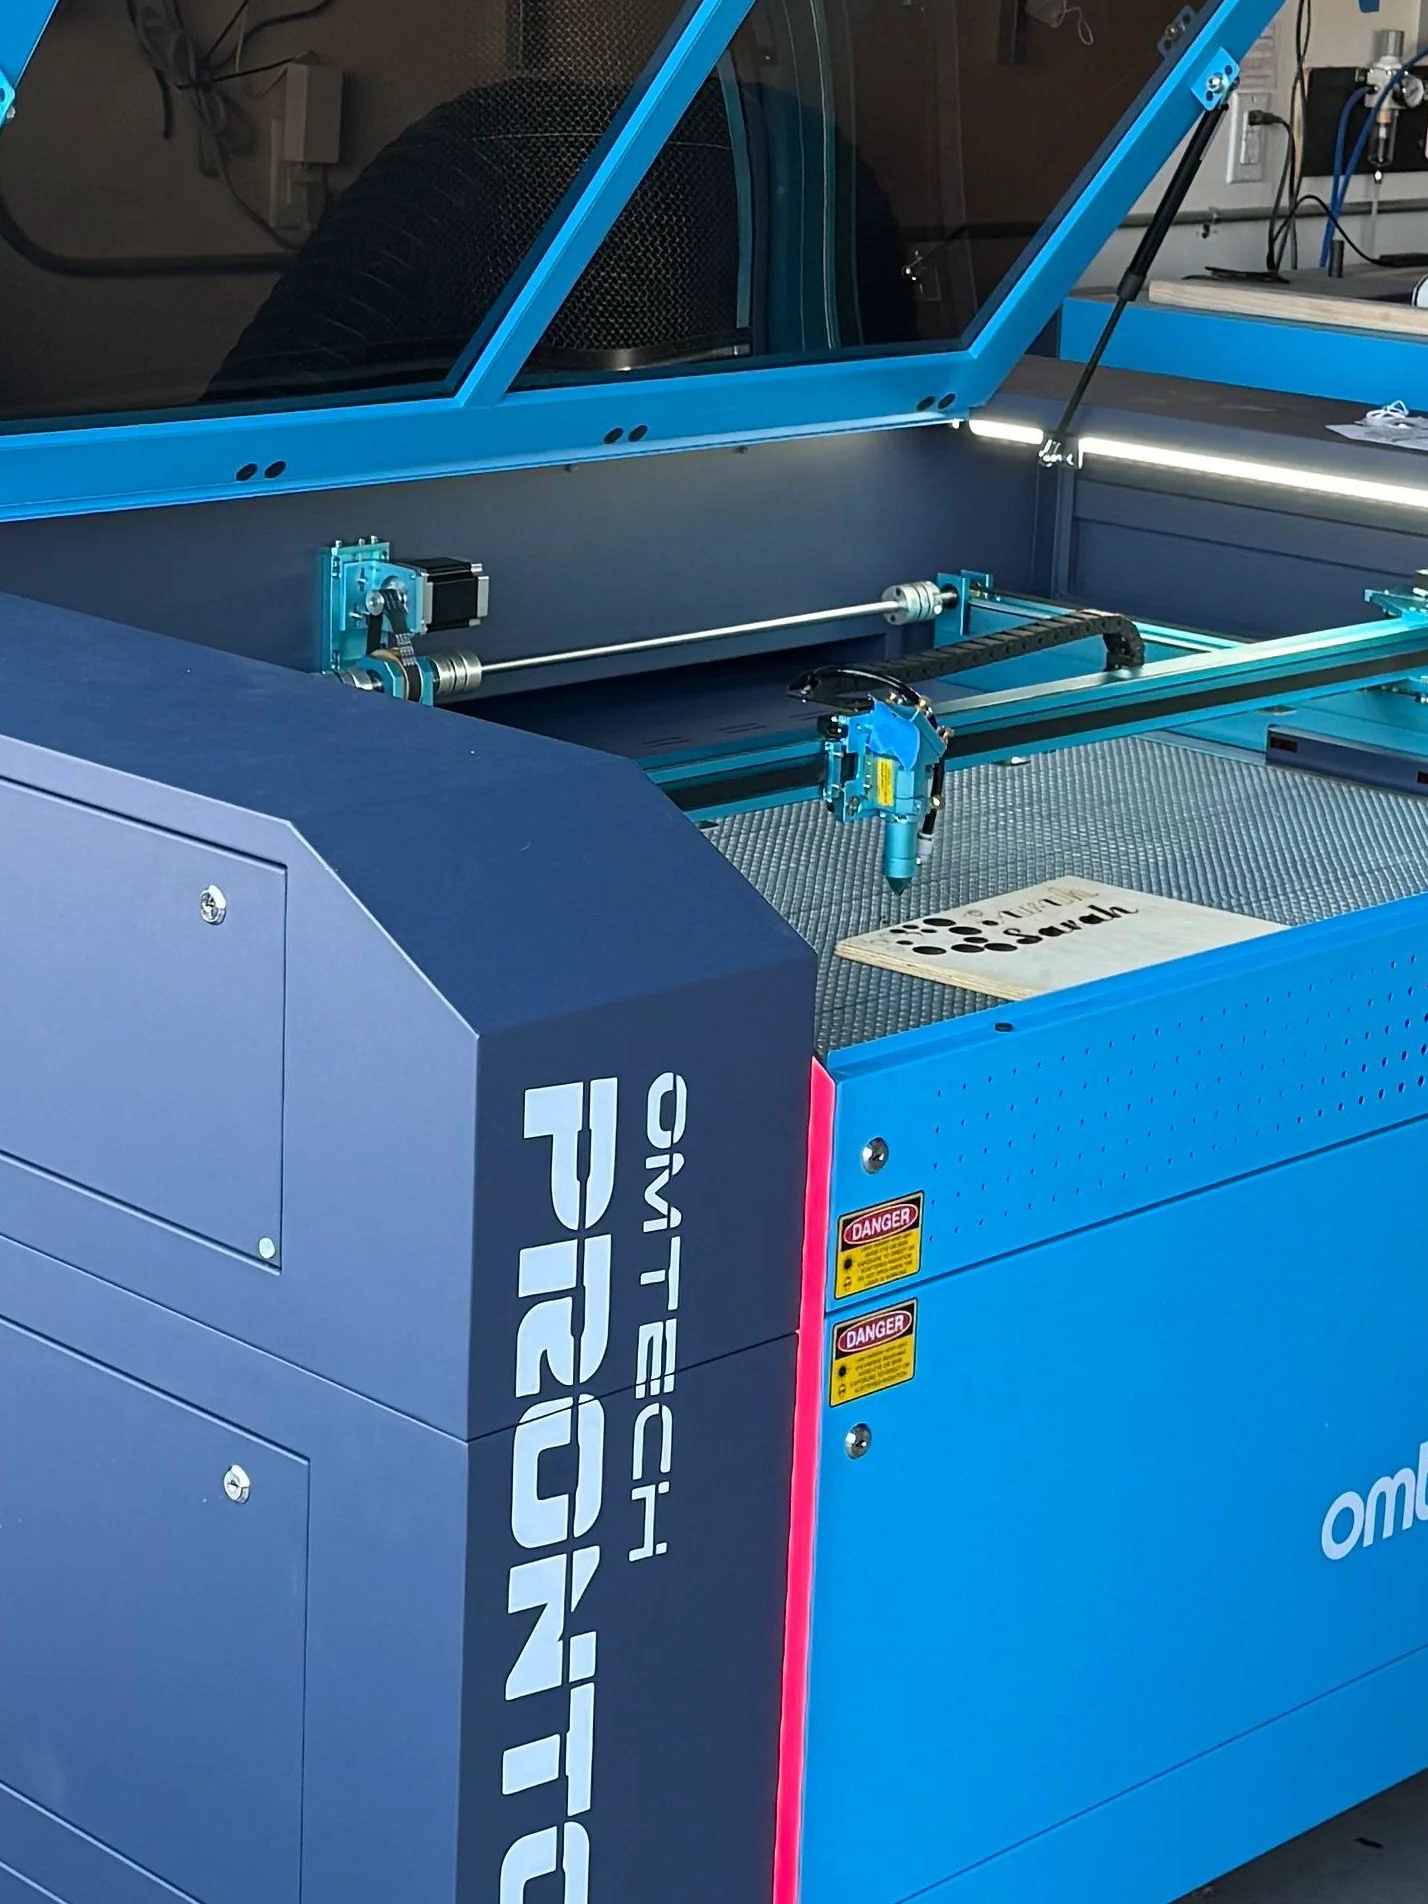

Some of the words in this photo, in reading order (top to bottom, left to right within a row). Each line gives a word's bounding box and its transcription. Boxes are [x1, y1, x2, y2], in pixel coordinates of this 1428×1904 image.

[1003, 905, 1139, 944] Sarah
[851, 1206, 911, 1242] DANGER
[630, 1070, 689, 1562] OMTECH
[846, 1314, 904, 1349] DANGER
